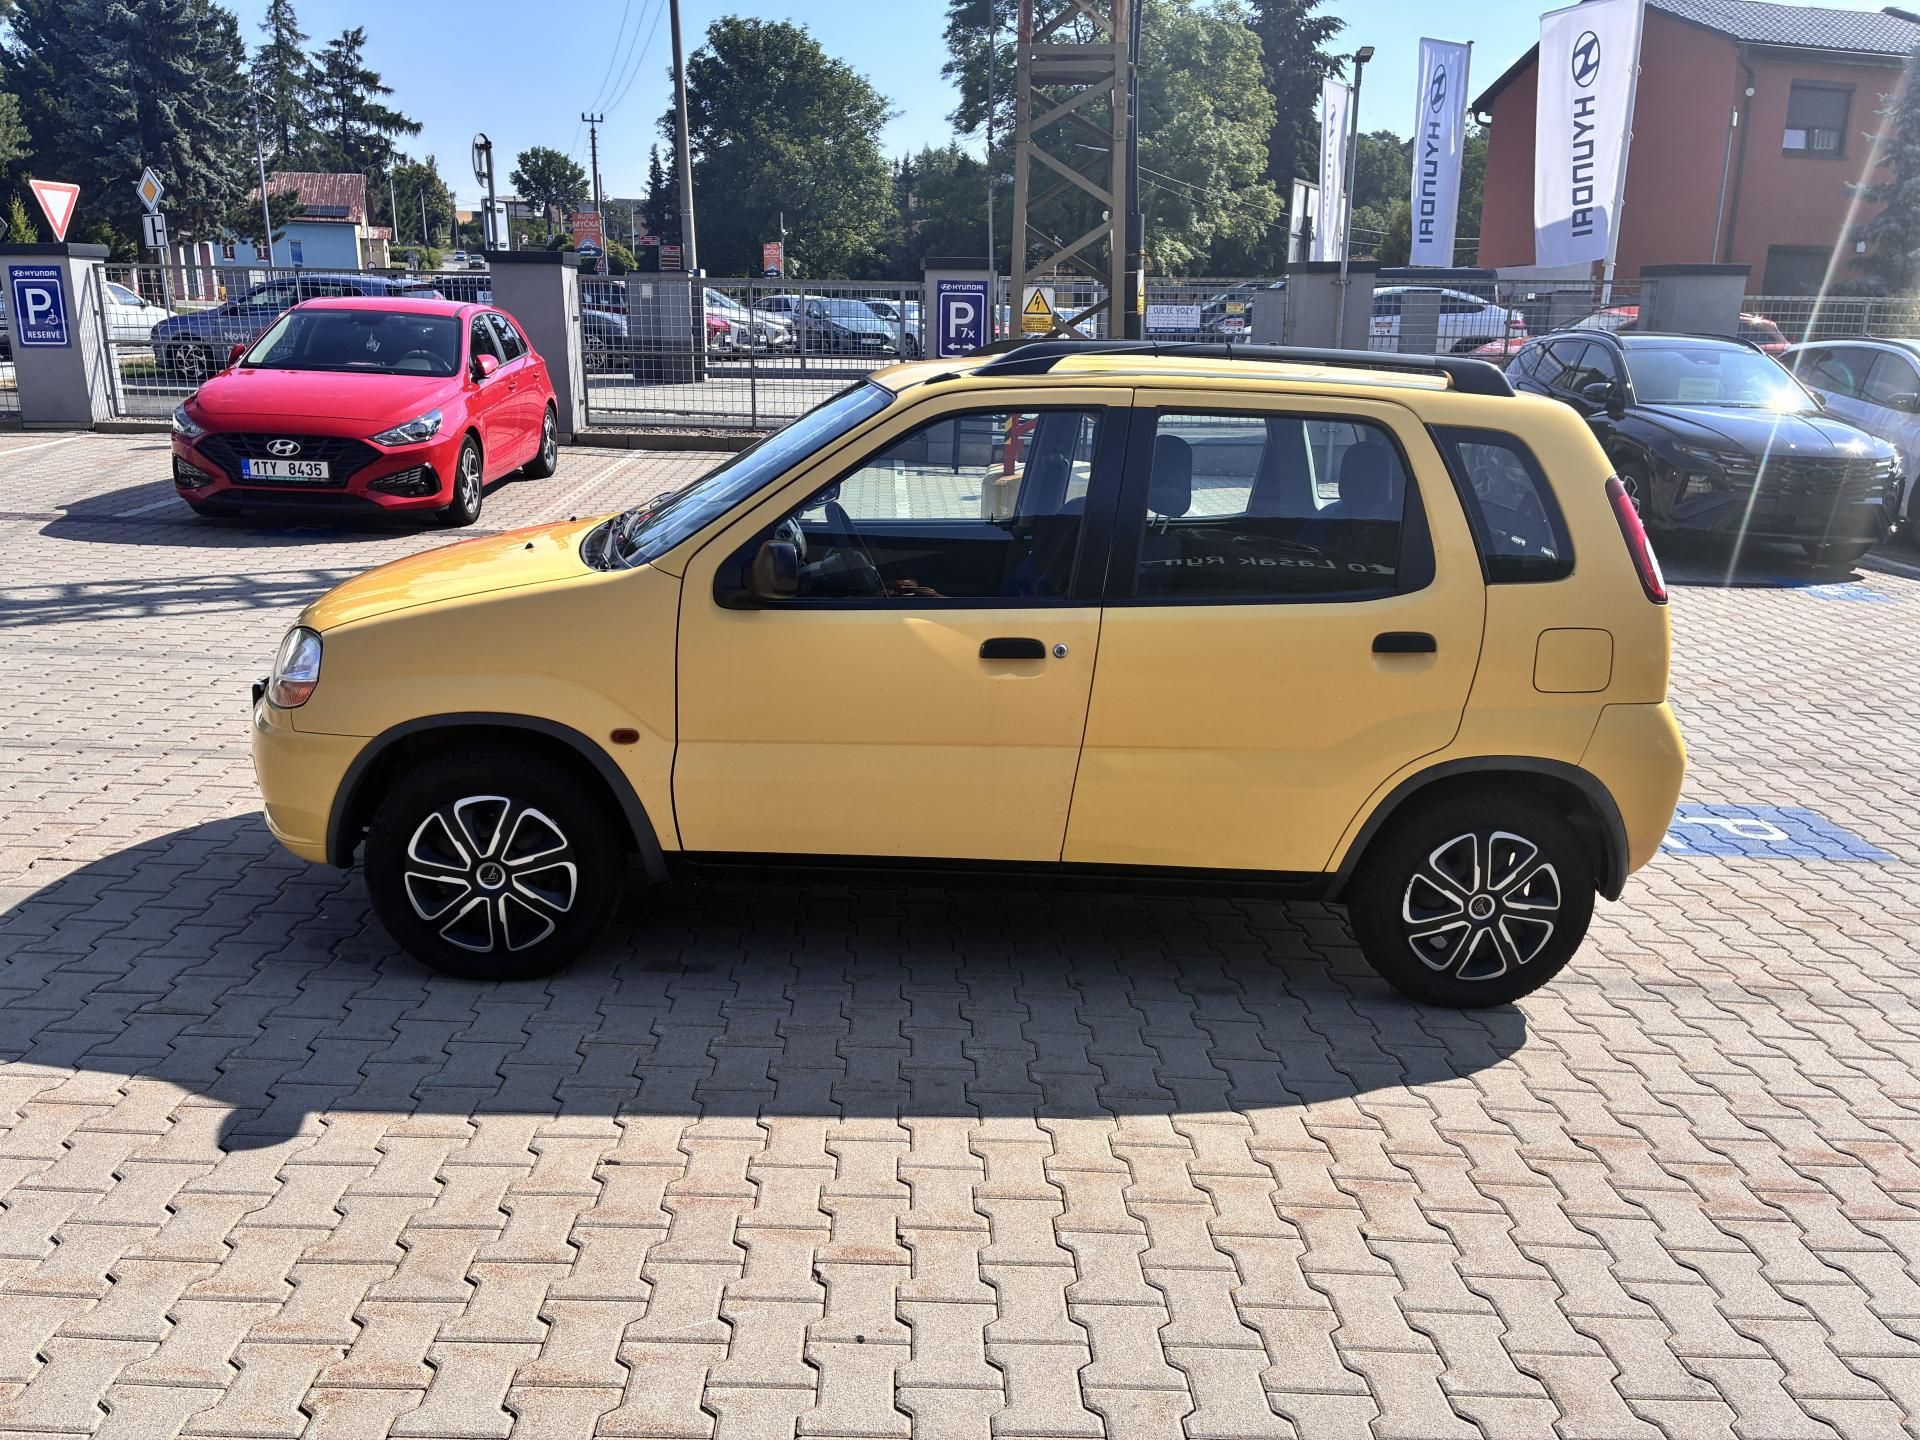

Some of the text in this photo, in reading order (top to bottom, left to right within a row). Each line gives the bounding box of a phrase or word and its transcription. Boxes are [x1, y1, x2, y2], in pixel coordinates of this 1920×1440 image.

[24, 288, 52, 325] P
[949, 301, 975, 338] P
[224, 330, 251, 342] Nový
[960, 327, 975, 339] 7x
[253, 461, 322, 477] 1TY 8435
